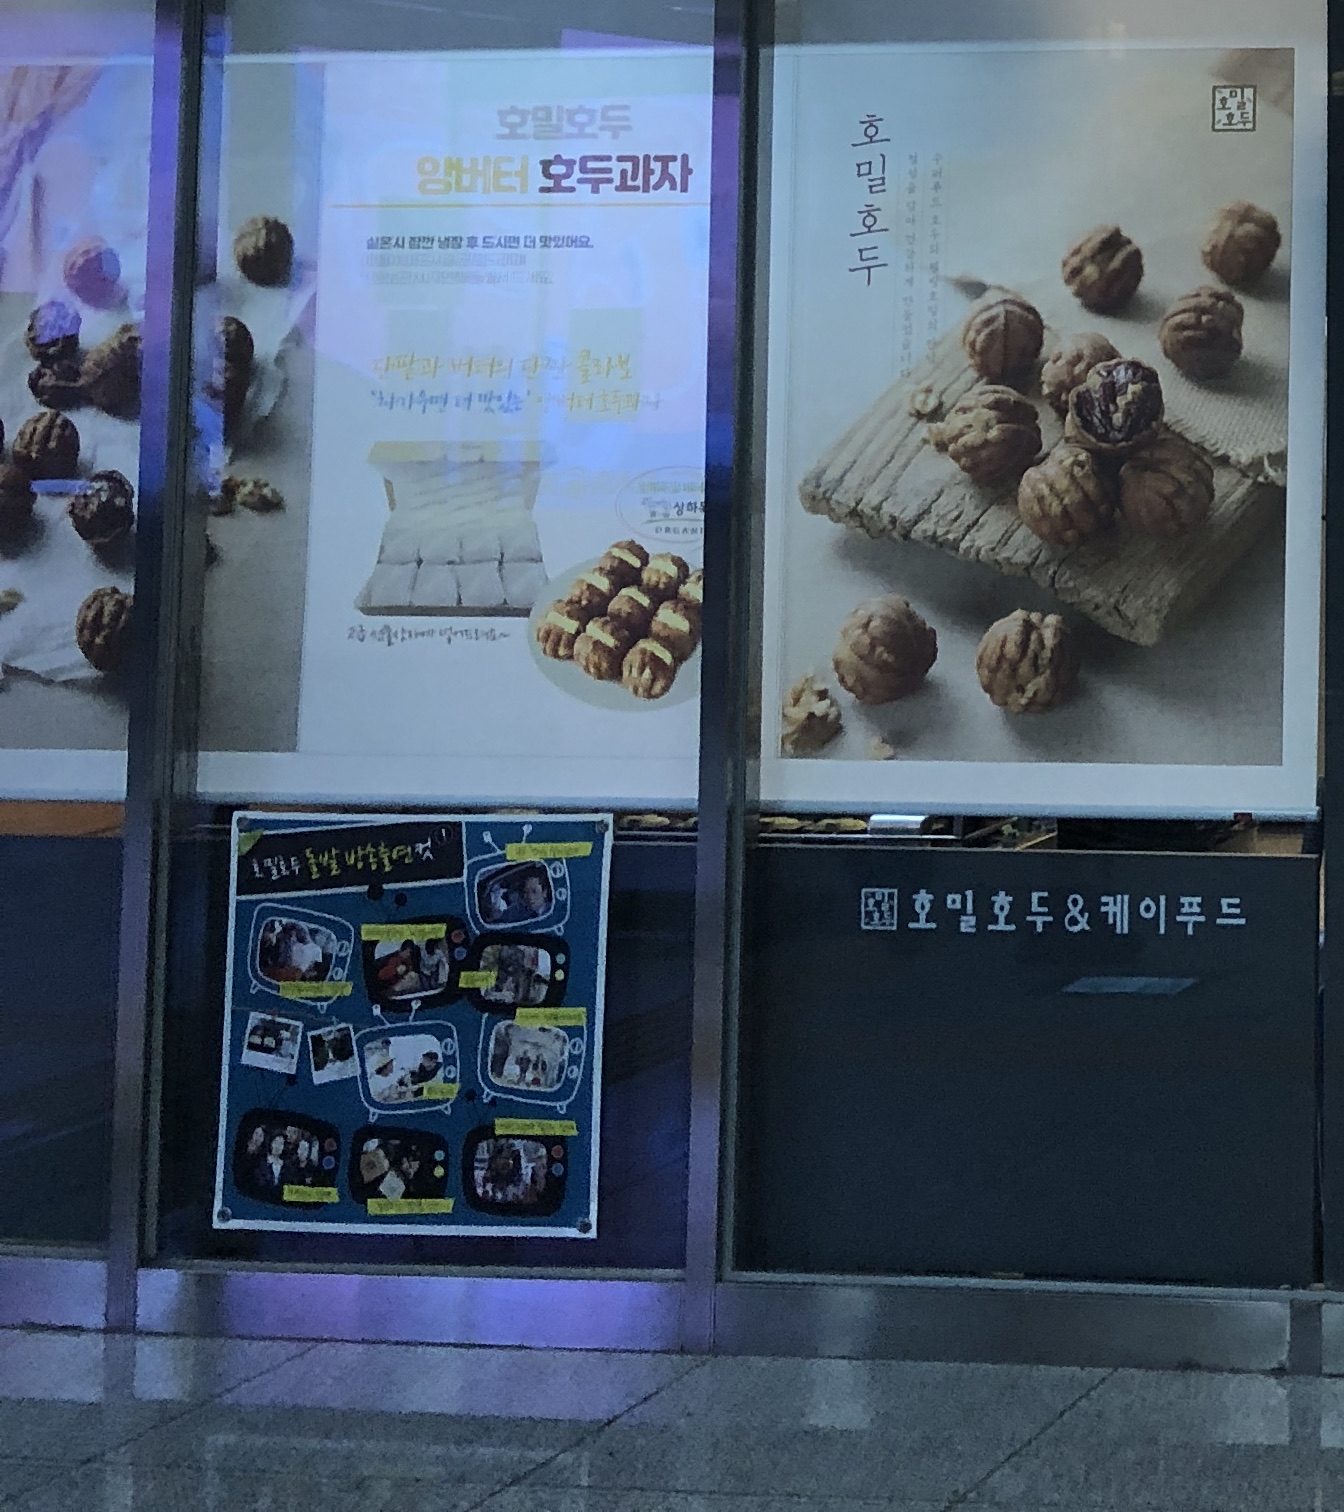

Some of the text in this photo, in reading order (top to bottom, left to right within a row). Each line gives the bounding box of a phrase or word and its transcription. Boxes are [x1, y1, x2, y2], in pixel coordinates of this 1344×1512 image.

[496, 104, 632, 140] 호밀호두
[1222, 112, 1252, 126] 호두
[538, 153, 693, 194] 호두과자
[849, 114, 890, 287] 호밀호두
